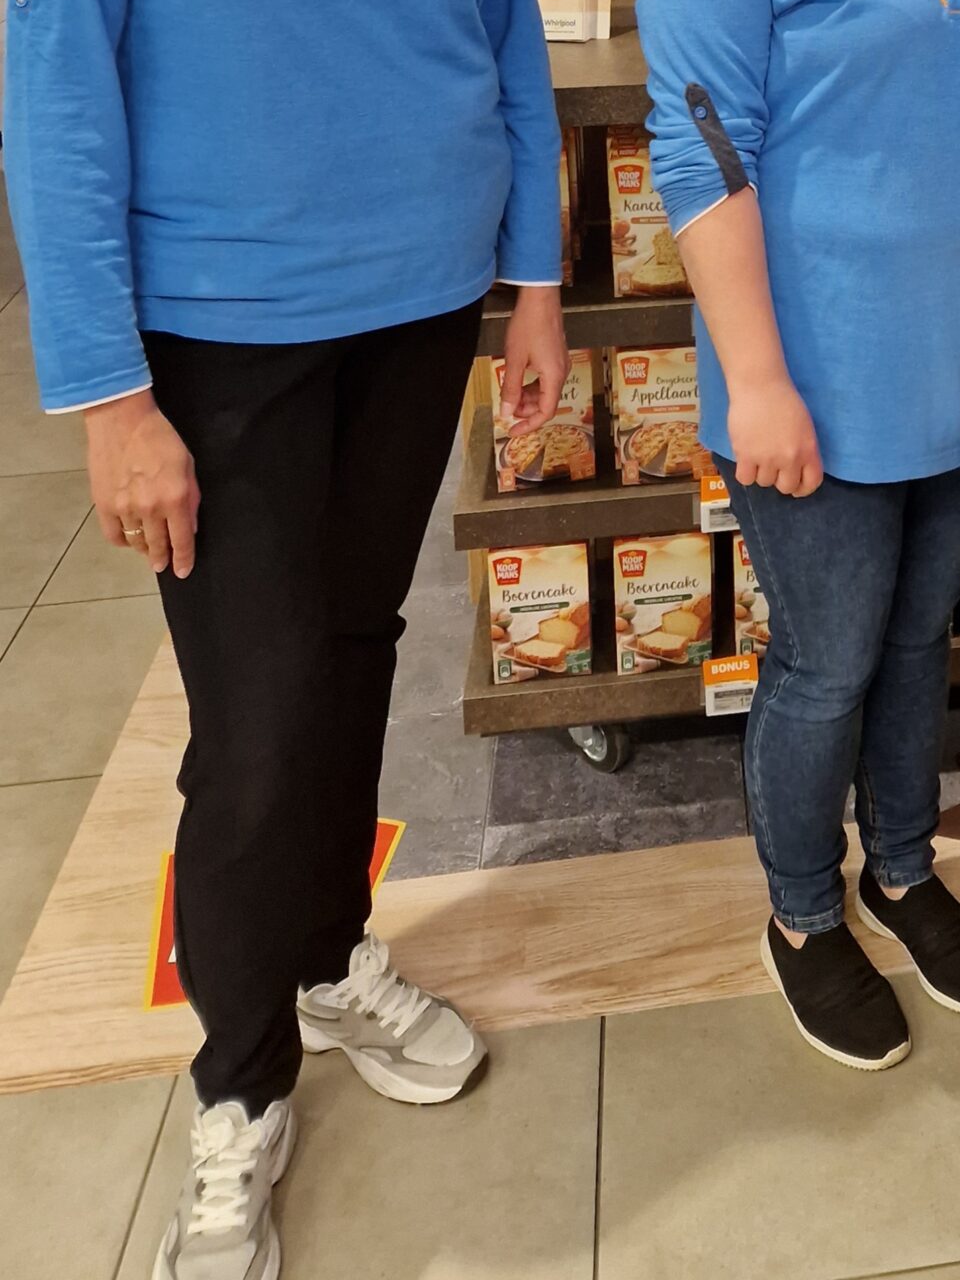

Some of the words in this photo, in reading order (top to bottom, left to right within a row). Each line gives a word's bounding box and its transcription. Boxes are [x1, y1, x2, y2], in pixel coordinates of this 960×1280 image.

[502, 584, 577, 602] Boerencake
[627, 576, 700, 595] Boerencake
[711, 659, 750, 675] BONUS
